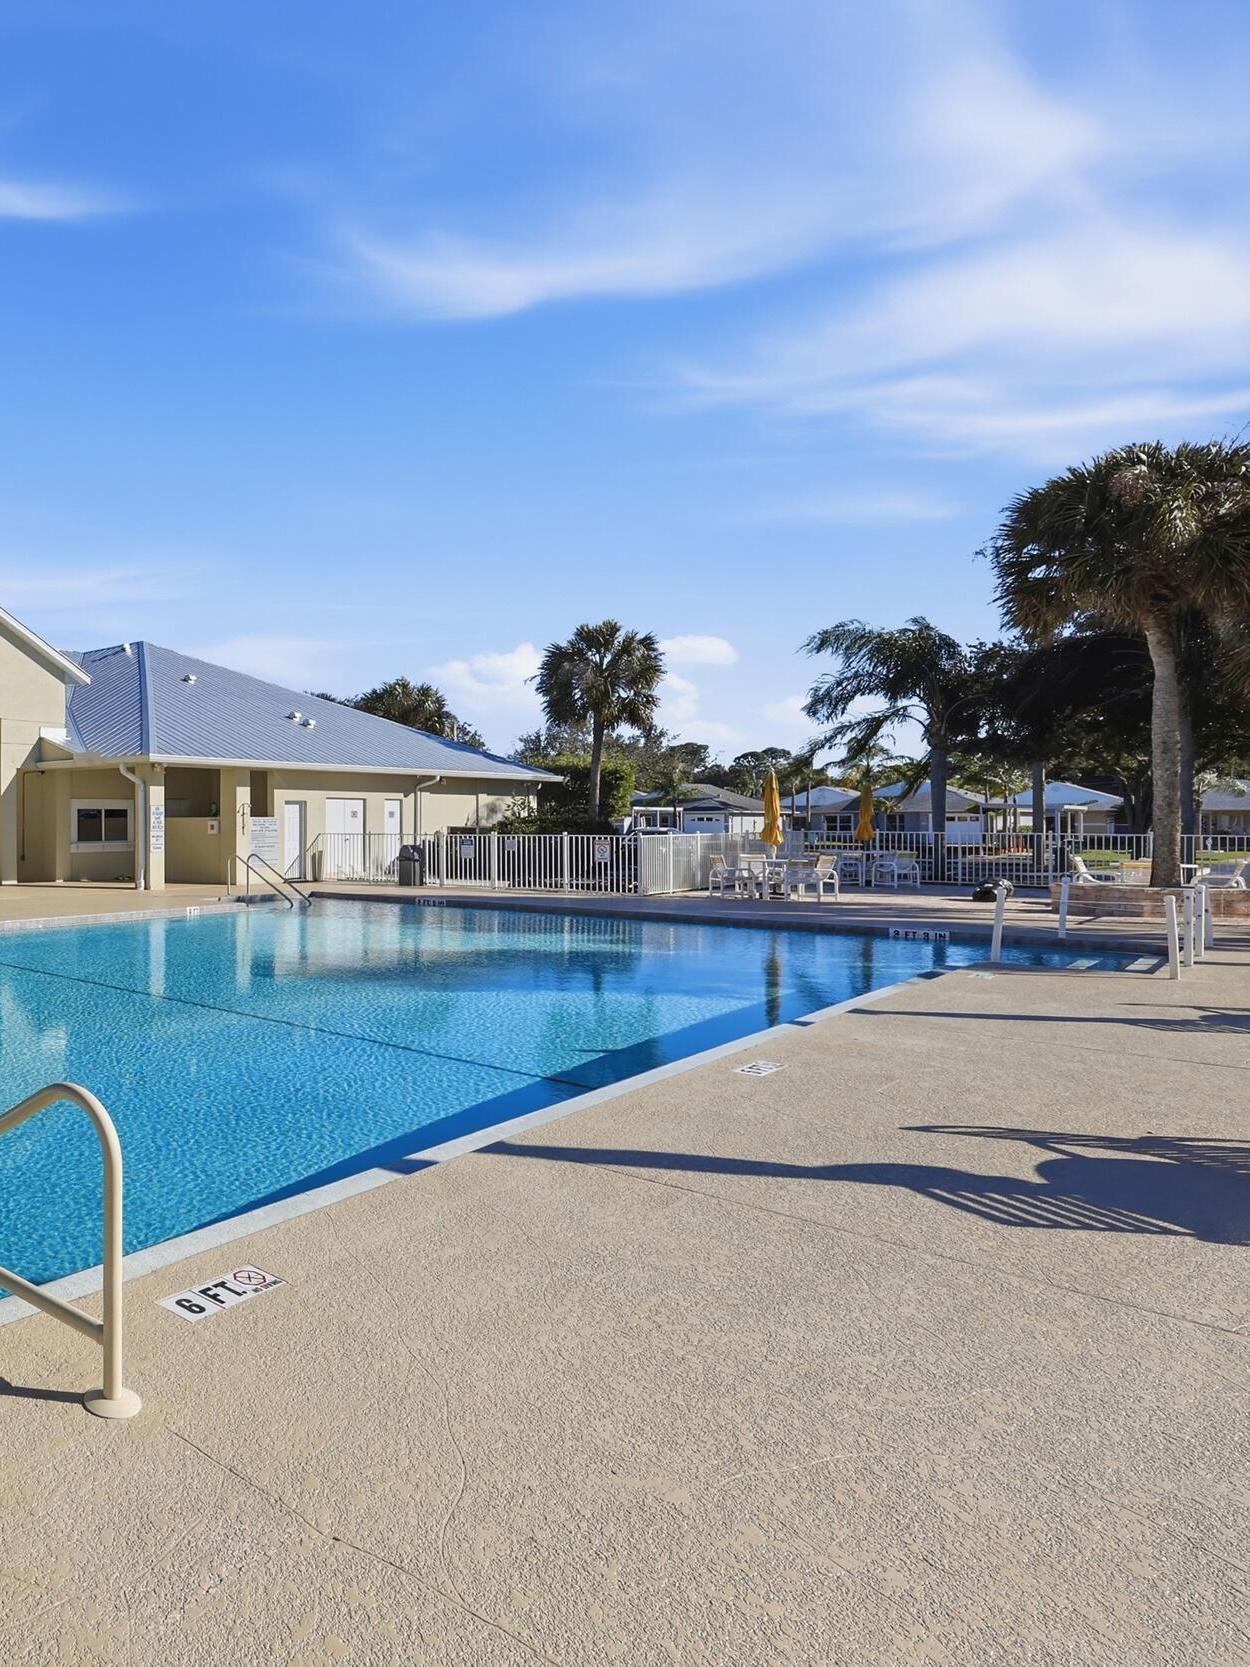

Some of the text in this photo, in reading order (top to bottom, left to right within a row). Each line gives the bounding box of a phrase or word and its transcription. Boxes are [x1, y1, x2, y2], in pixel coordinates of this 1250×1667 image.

[904, 930, 917, 940] FT
[922, 931, 930, 941] 3
[934, 932, 947, 941] IN
[175, 1280, 247, 1314] 6 FT.
